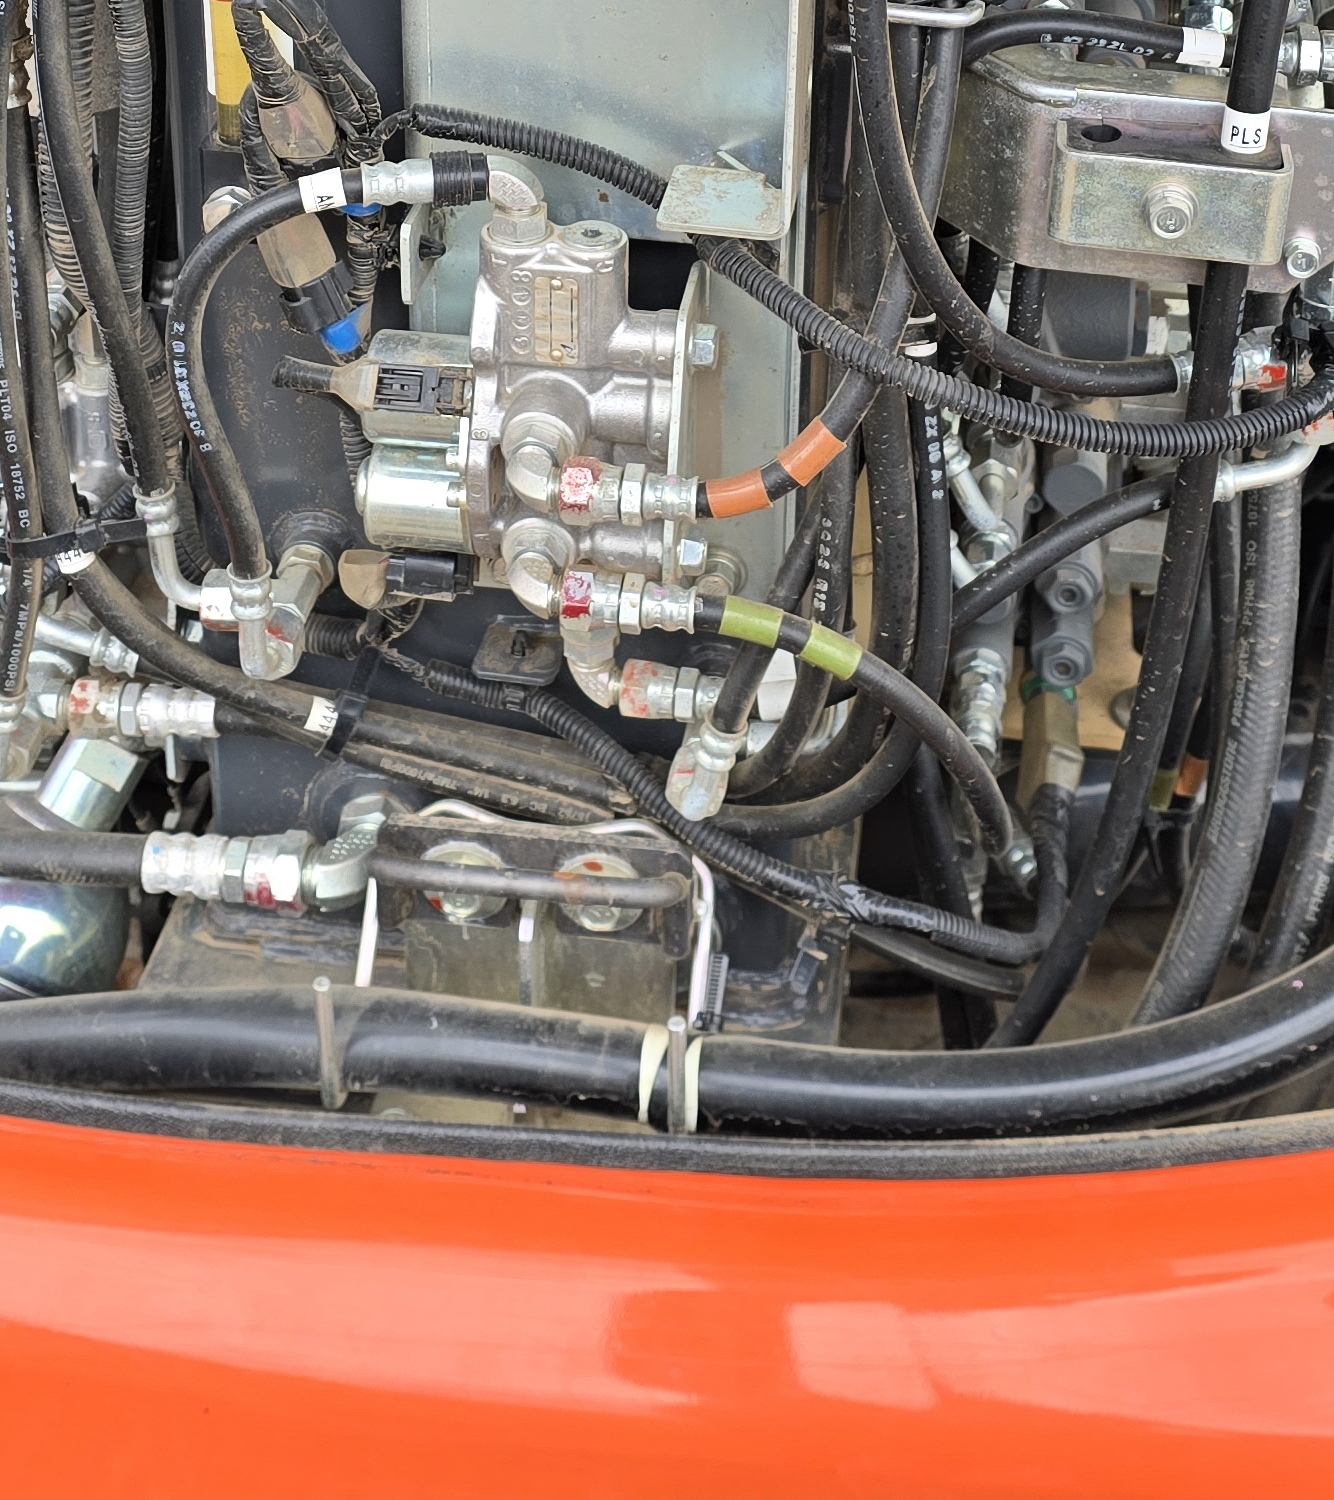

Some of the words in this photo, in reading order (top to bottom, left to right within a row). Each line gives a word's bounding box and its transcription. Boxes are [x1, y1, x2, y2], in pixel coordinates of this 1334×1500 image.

[1229, 125, 1262, 145] PLS
[4, 429, 18, 454] ISO
[10, 463, 26, 500] 18752
[18, 509, 31, 528] BC
[3, 603, 30, 692] 7MPa/1000PSI
